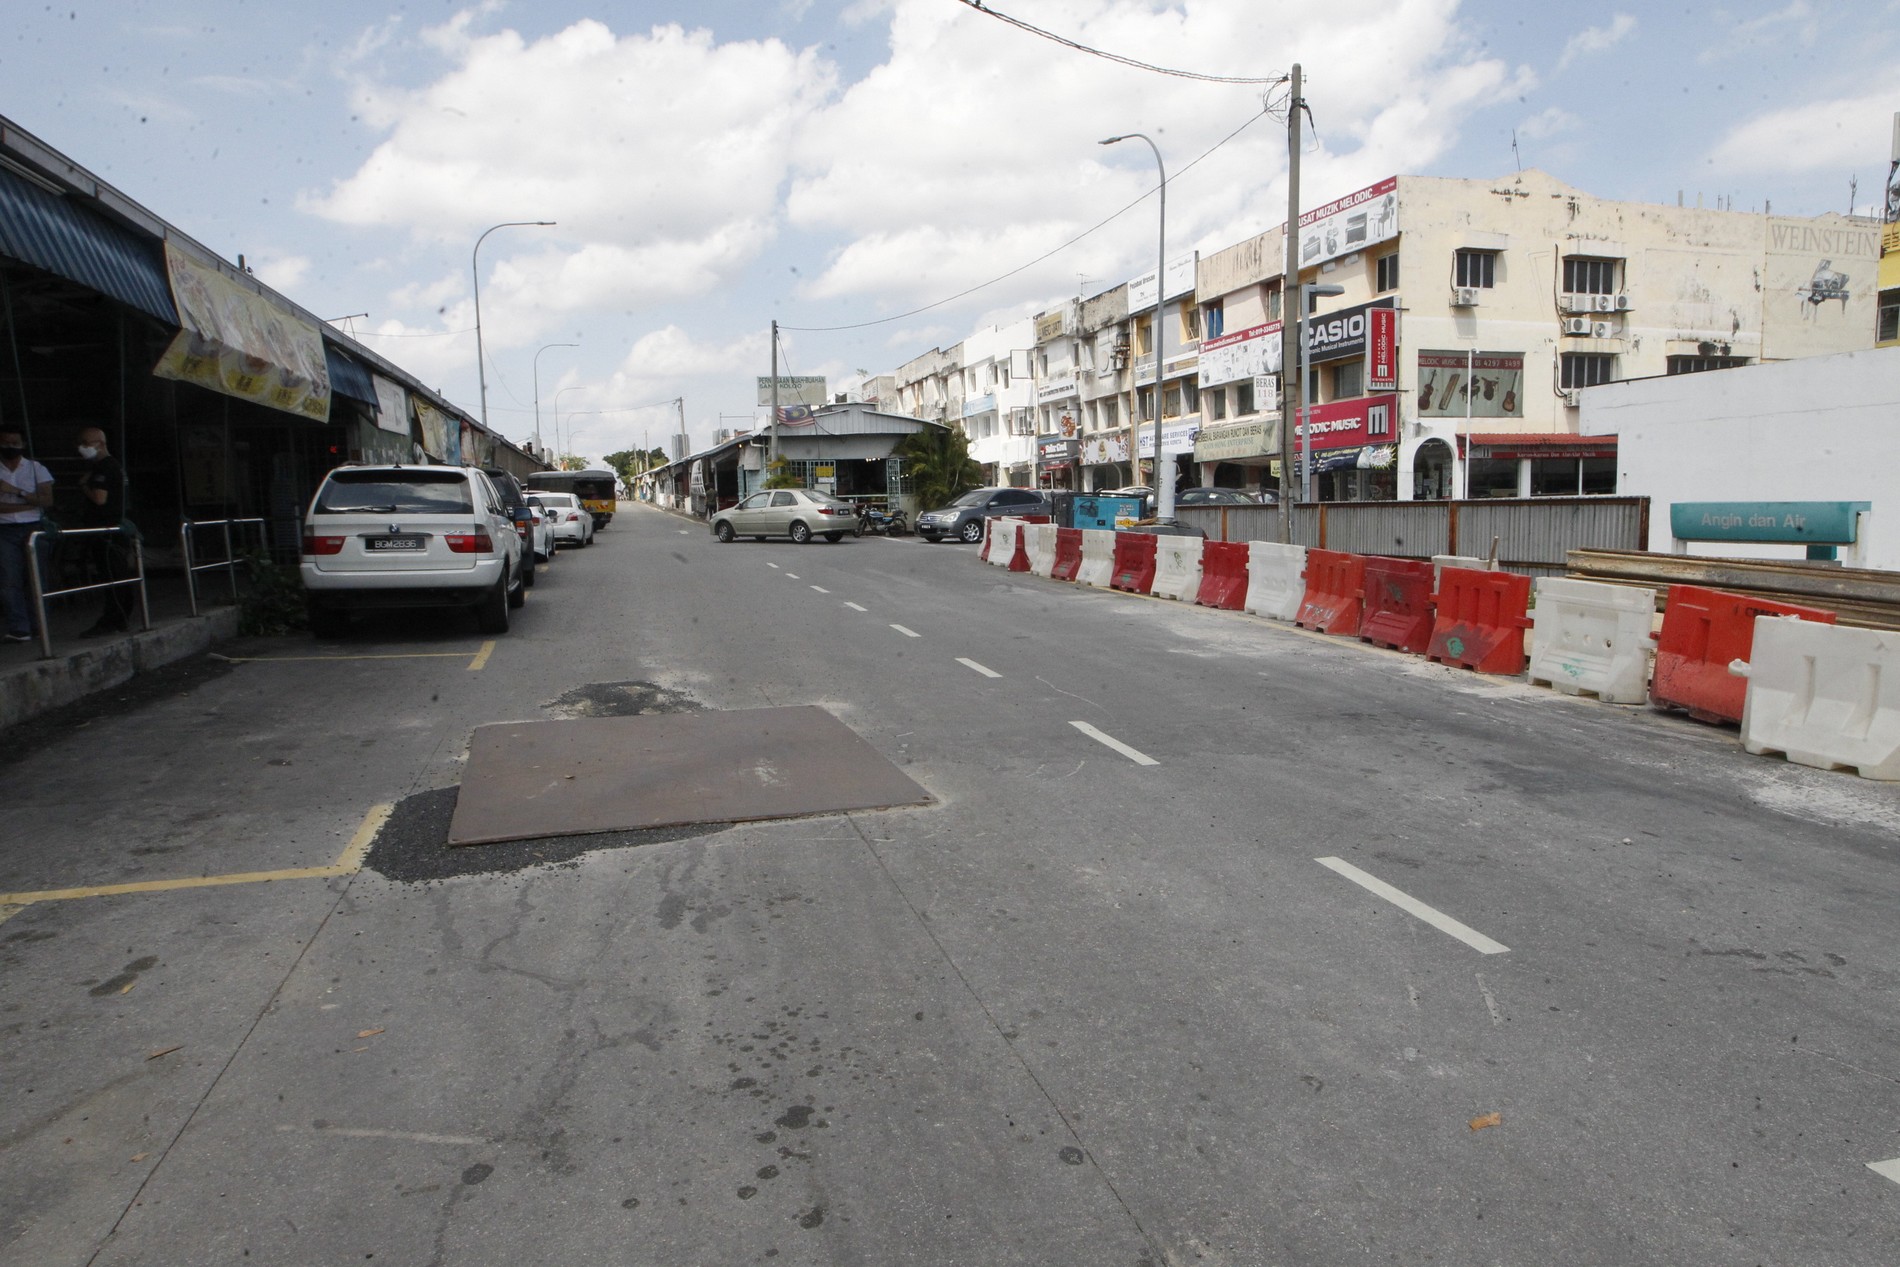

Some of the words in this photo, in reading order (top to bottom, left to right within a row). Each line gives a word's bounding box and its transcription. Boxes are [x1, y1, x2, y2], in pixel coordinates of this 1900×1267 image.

[1298, 211, 1316, 227] USAT
[1316, 202, 1339, 220] MUZIK
[1340, 188, 1373, 211] MELODIC
[1771, 224, 1878, 257] WEINSTEIN
[1321, 342, 1338, 353] Musical
[1338, 336, 1365, 348] Instruments
[1483, 359, 1500, 367] 4297
[1255, 377, 1275, 389] BERAS
[1257, 389, 1274, 398] 118
[1330, 417, 1361, 432] MUSIC
[1701, 512, 1743, 530] Angin
[1748, 512, 1777, 527] dan
[1782, 513, 1806, 528] Air
[374, 539, 417, 549] BGM2836
